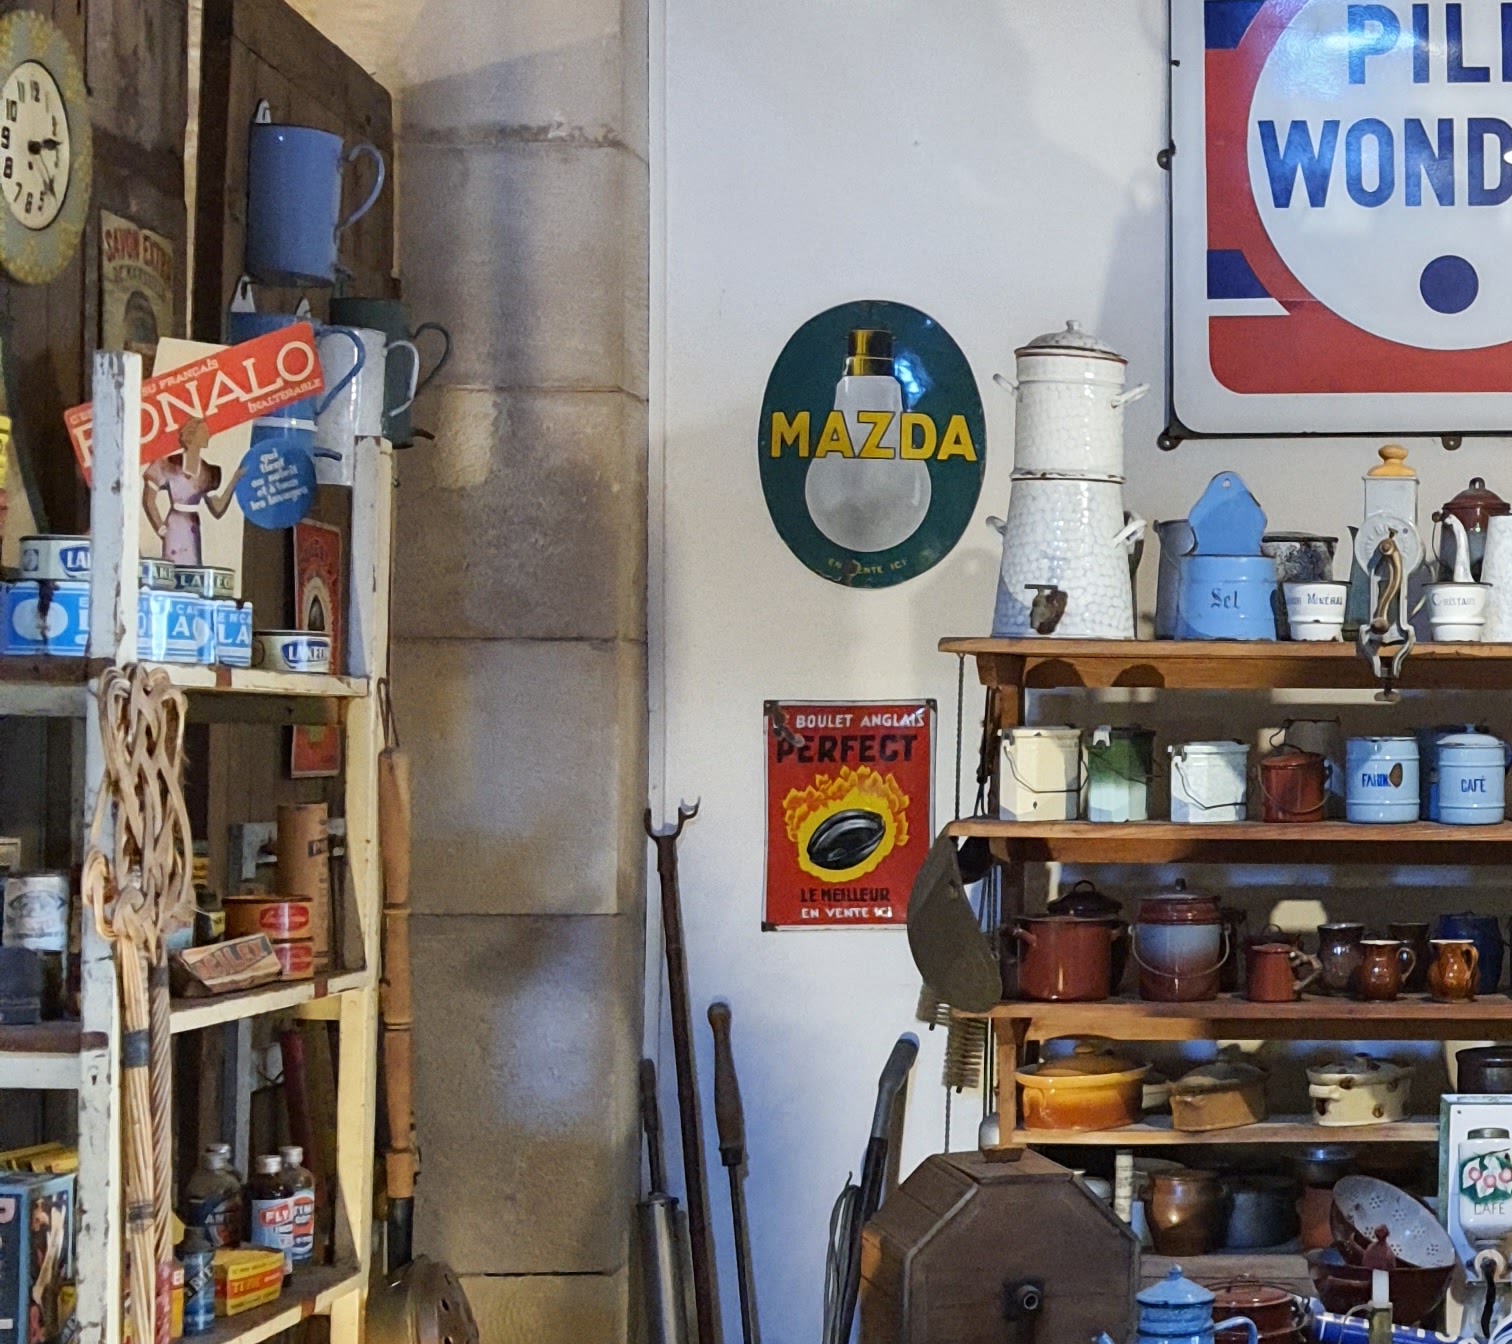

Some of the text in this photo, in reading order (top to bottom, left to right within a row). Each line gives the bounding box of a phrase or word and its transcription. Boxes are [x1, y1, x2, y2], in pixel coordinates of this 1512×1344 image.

[1, 126, 11, 150] 9
[3, 157, 14, 179] 8
[769, 409, 978, 461] MAZDA
[851, 562, 884, 575] ENTE
[1209, 587, 1241, 610] Sel
[796, 714, 853, 729] BOULET
[860, 709, 926, 728] ANGLAIS
[776, 733, 918, 764] PERFECT
[1461, 774, 1487, 793] CAFÉ
[800, 886, 891, 903] LE MEILLEUR
[801, 908, 820, 919] EN
[825, 907, 870, 919] VENTE
